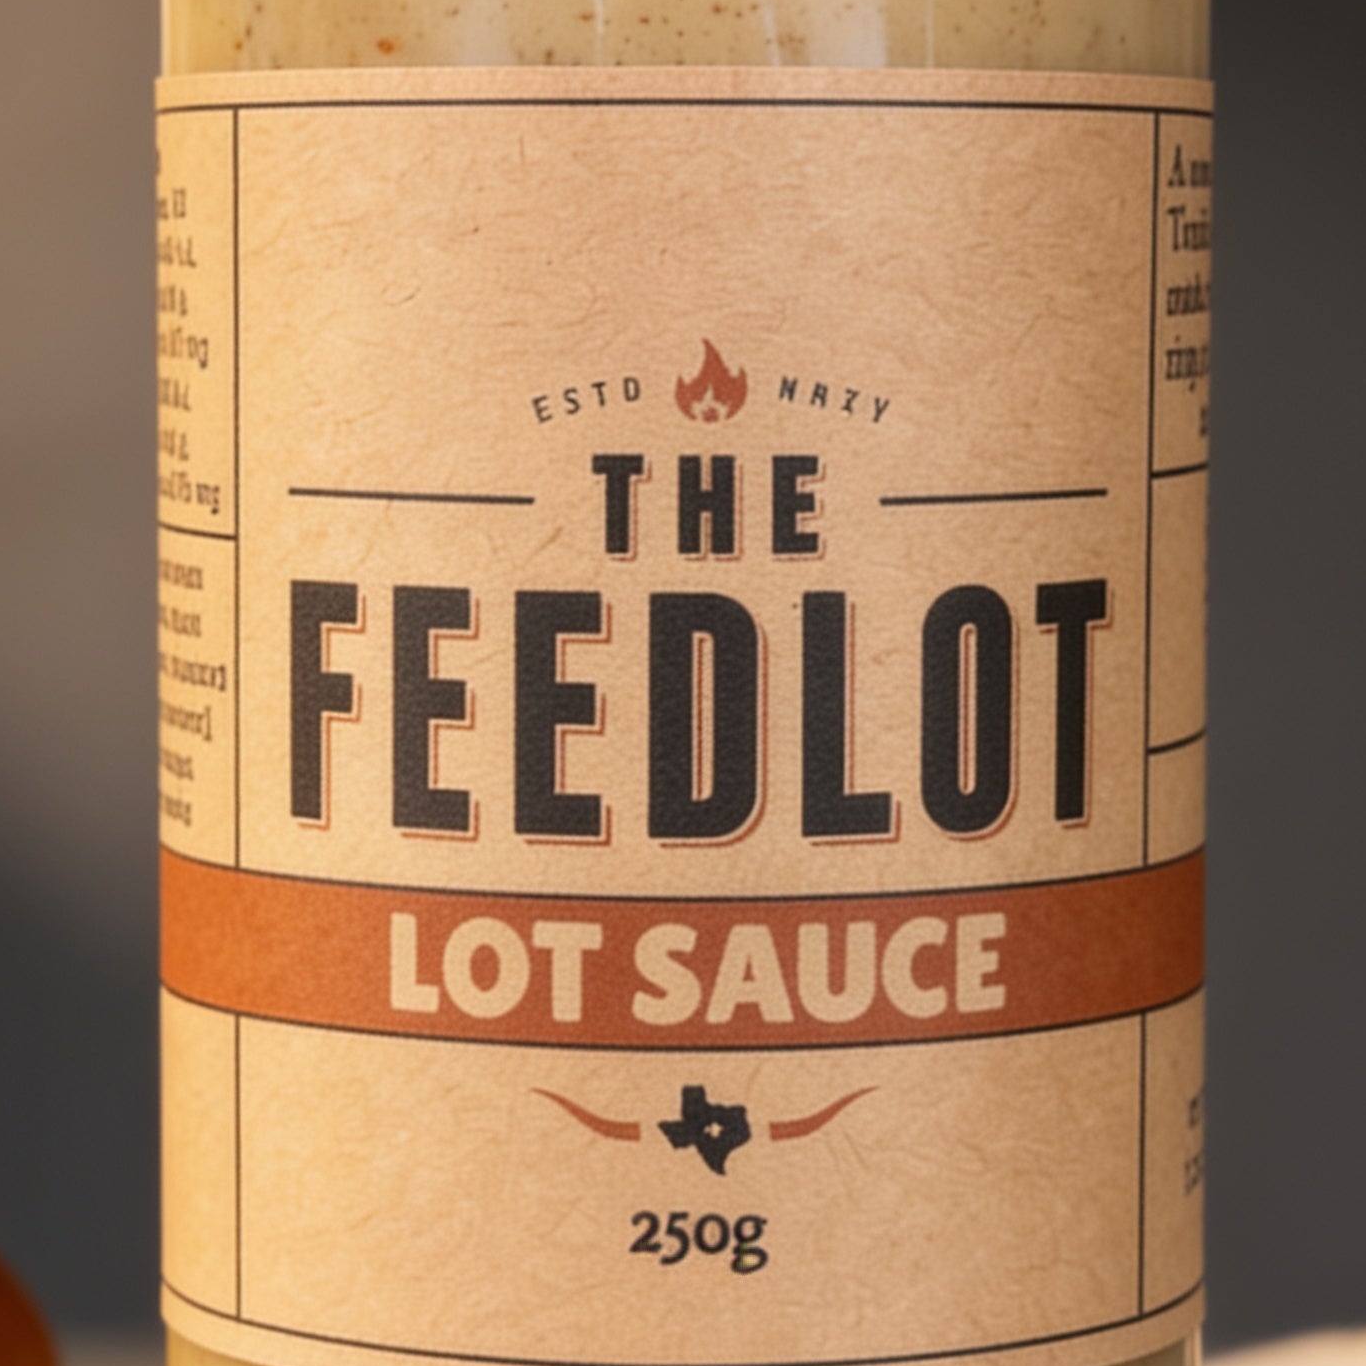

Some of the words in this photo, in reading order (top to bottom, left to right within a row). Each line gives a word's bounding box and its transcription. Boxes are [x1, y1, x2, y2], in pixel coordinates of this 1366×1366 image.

[531, 375, 641, 423] ESTD
[591, 453, 826, 561] THE
[290, 578, 1112, 846] FEEDLOT
[389, 912, 603, 1022] LOT
[631, 912, 1007, 1026] SAUCE
[629, 1210, 769, 1275] 250g
